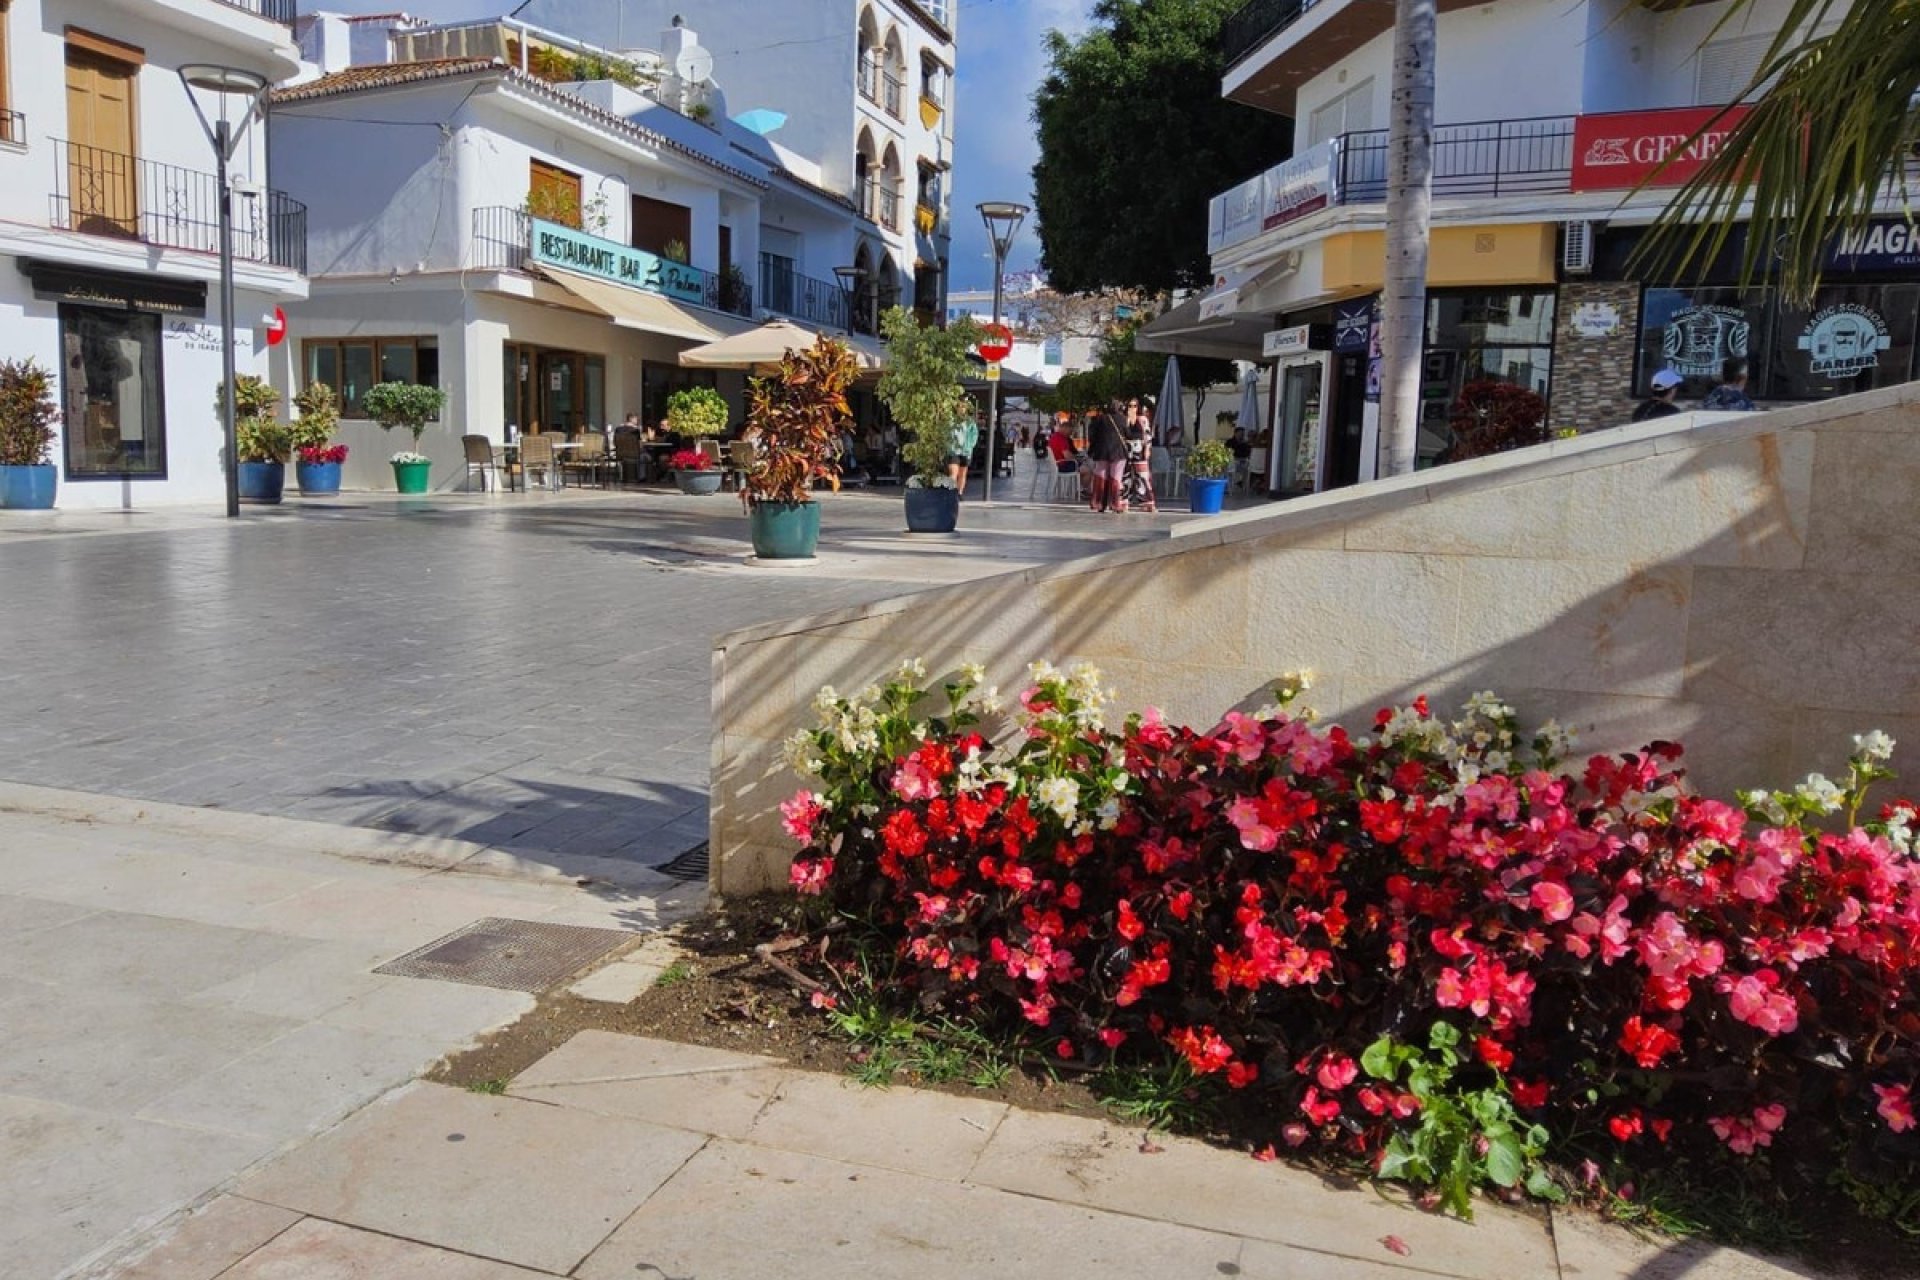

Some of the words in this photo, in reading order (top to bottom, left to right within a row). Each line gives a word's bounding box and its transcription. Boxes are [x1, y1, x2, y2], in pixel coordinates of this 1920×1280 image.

[1633, 131, 1742, 164] GENE
[540, 231, 615, 275] RESTAURANTE
[620, 255, 640, 281] BAR
[1804, 306, 1835, 334] MAGIC
[1839, 303, 1887, 334] SCISSORS
[1812, 356, 1876, 371] BARBER
[1828, 367, 1860, 377] SHOP
